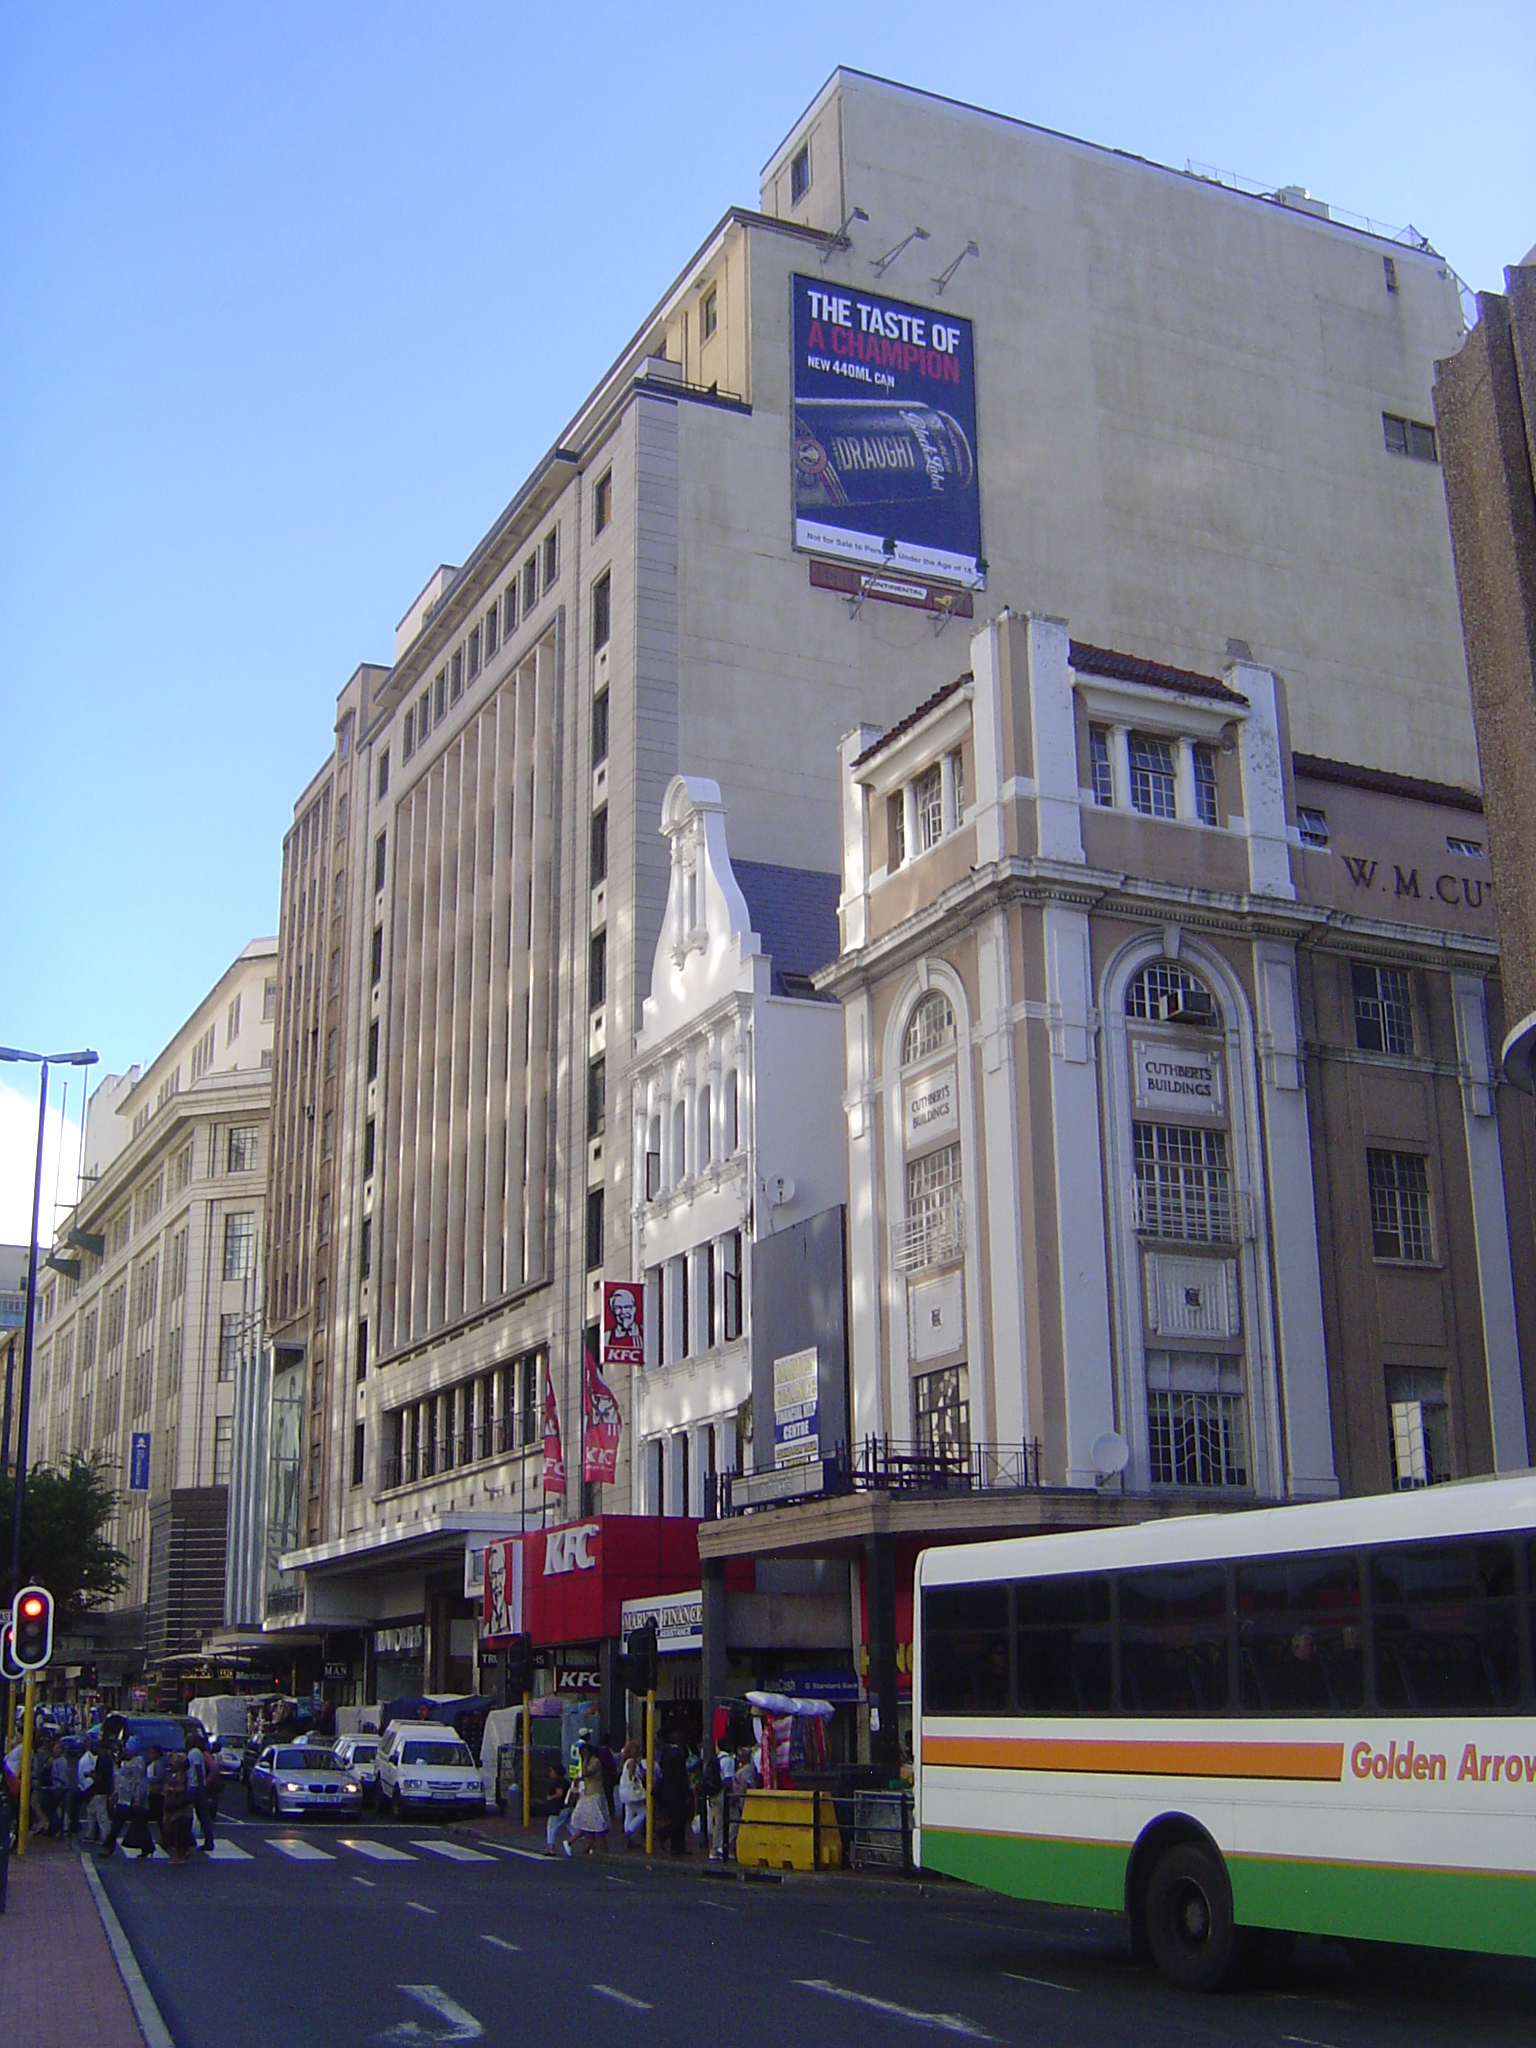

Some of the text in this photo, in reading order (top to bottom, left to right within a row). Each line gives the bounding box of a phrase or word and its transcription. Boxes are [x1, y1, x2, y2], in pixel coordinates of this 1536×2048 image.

[807, 290, 960, 354] THE TASTE OF
[809, 321, 960, 385] A CHAMPION
[807, 355, 895, 388] NEW 440ML CAN
[837, 436, 915, 470] DRAUGHT
[899, 410, 938, 463] Black
[925, 456, 945, 492] Label
[807, 532, 821, 543] Not
[823, 534, 834, 545] for
[836, 538, 853, 549] Sale
[854, 542, 863, 551] to
[898, 553, 921, 565] Under
[923, 557, 936, 567] the
[937, 560, 952, 572] Age
[953, 564, 962, 573] of
[1147, 1077, 1212, 1097] BUILDINGS
[912, 1102, 950, 1129] BUILDINGS
[607, 1349, 641, 1361] KFC
[783, 1420, 809, 1440] CENTRE
[543, 1524, 600, 1576] KFC
[662, 1604, 702, 1627] FINANCE
[324, 1665, 347, 1676] MAN
[560, 1671, 601, 1687] KFC
[812, 1682, 857, 1690] Standard Bank
[1351, 1740, 1446, 1780] Golden
